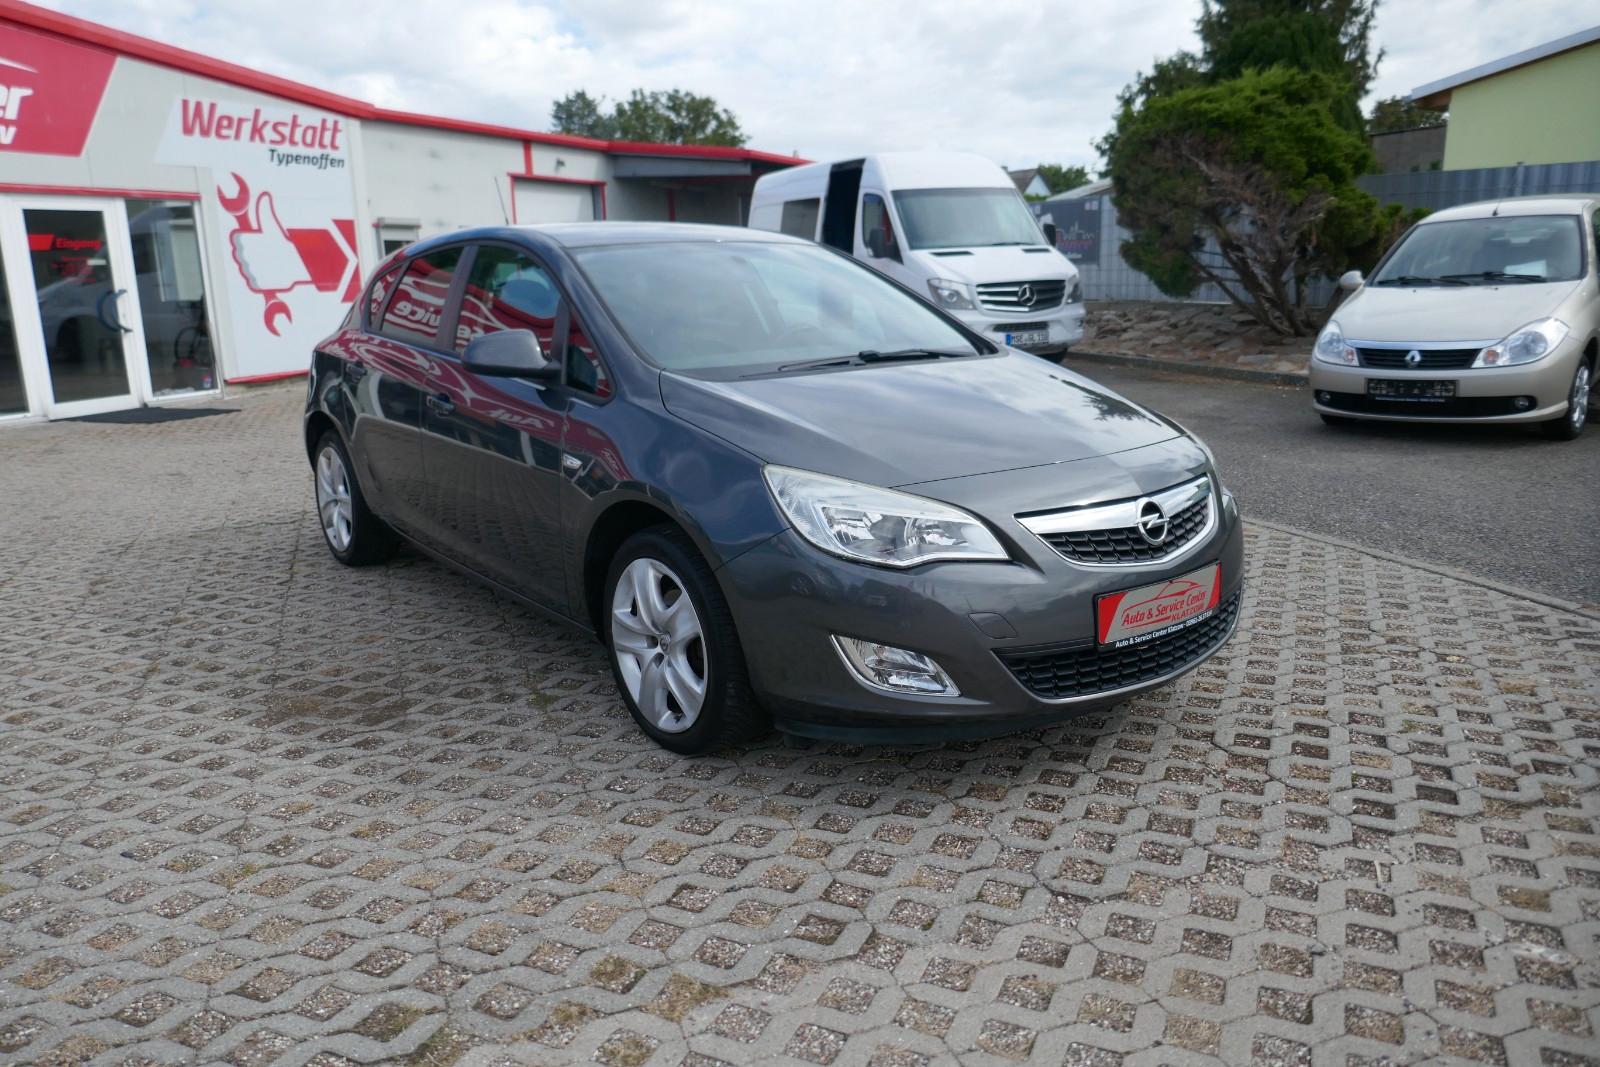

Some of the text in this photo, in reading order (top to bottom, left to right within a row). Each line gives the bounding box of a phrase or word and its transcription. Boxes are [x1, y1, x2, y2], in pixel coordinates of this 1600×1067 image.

[182, 99, 343, 151] Werkstatt
[269, 148, 345, 170] Typenoffen
[1123, 590, 1206, 626] Auto & Service Center
[1115, 640, 1129, 648] Auto
[1129, 637, 1134, 645] &
[1134, 632, 1152, 643] Service
[1152, 628, 1168, 639] Center
